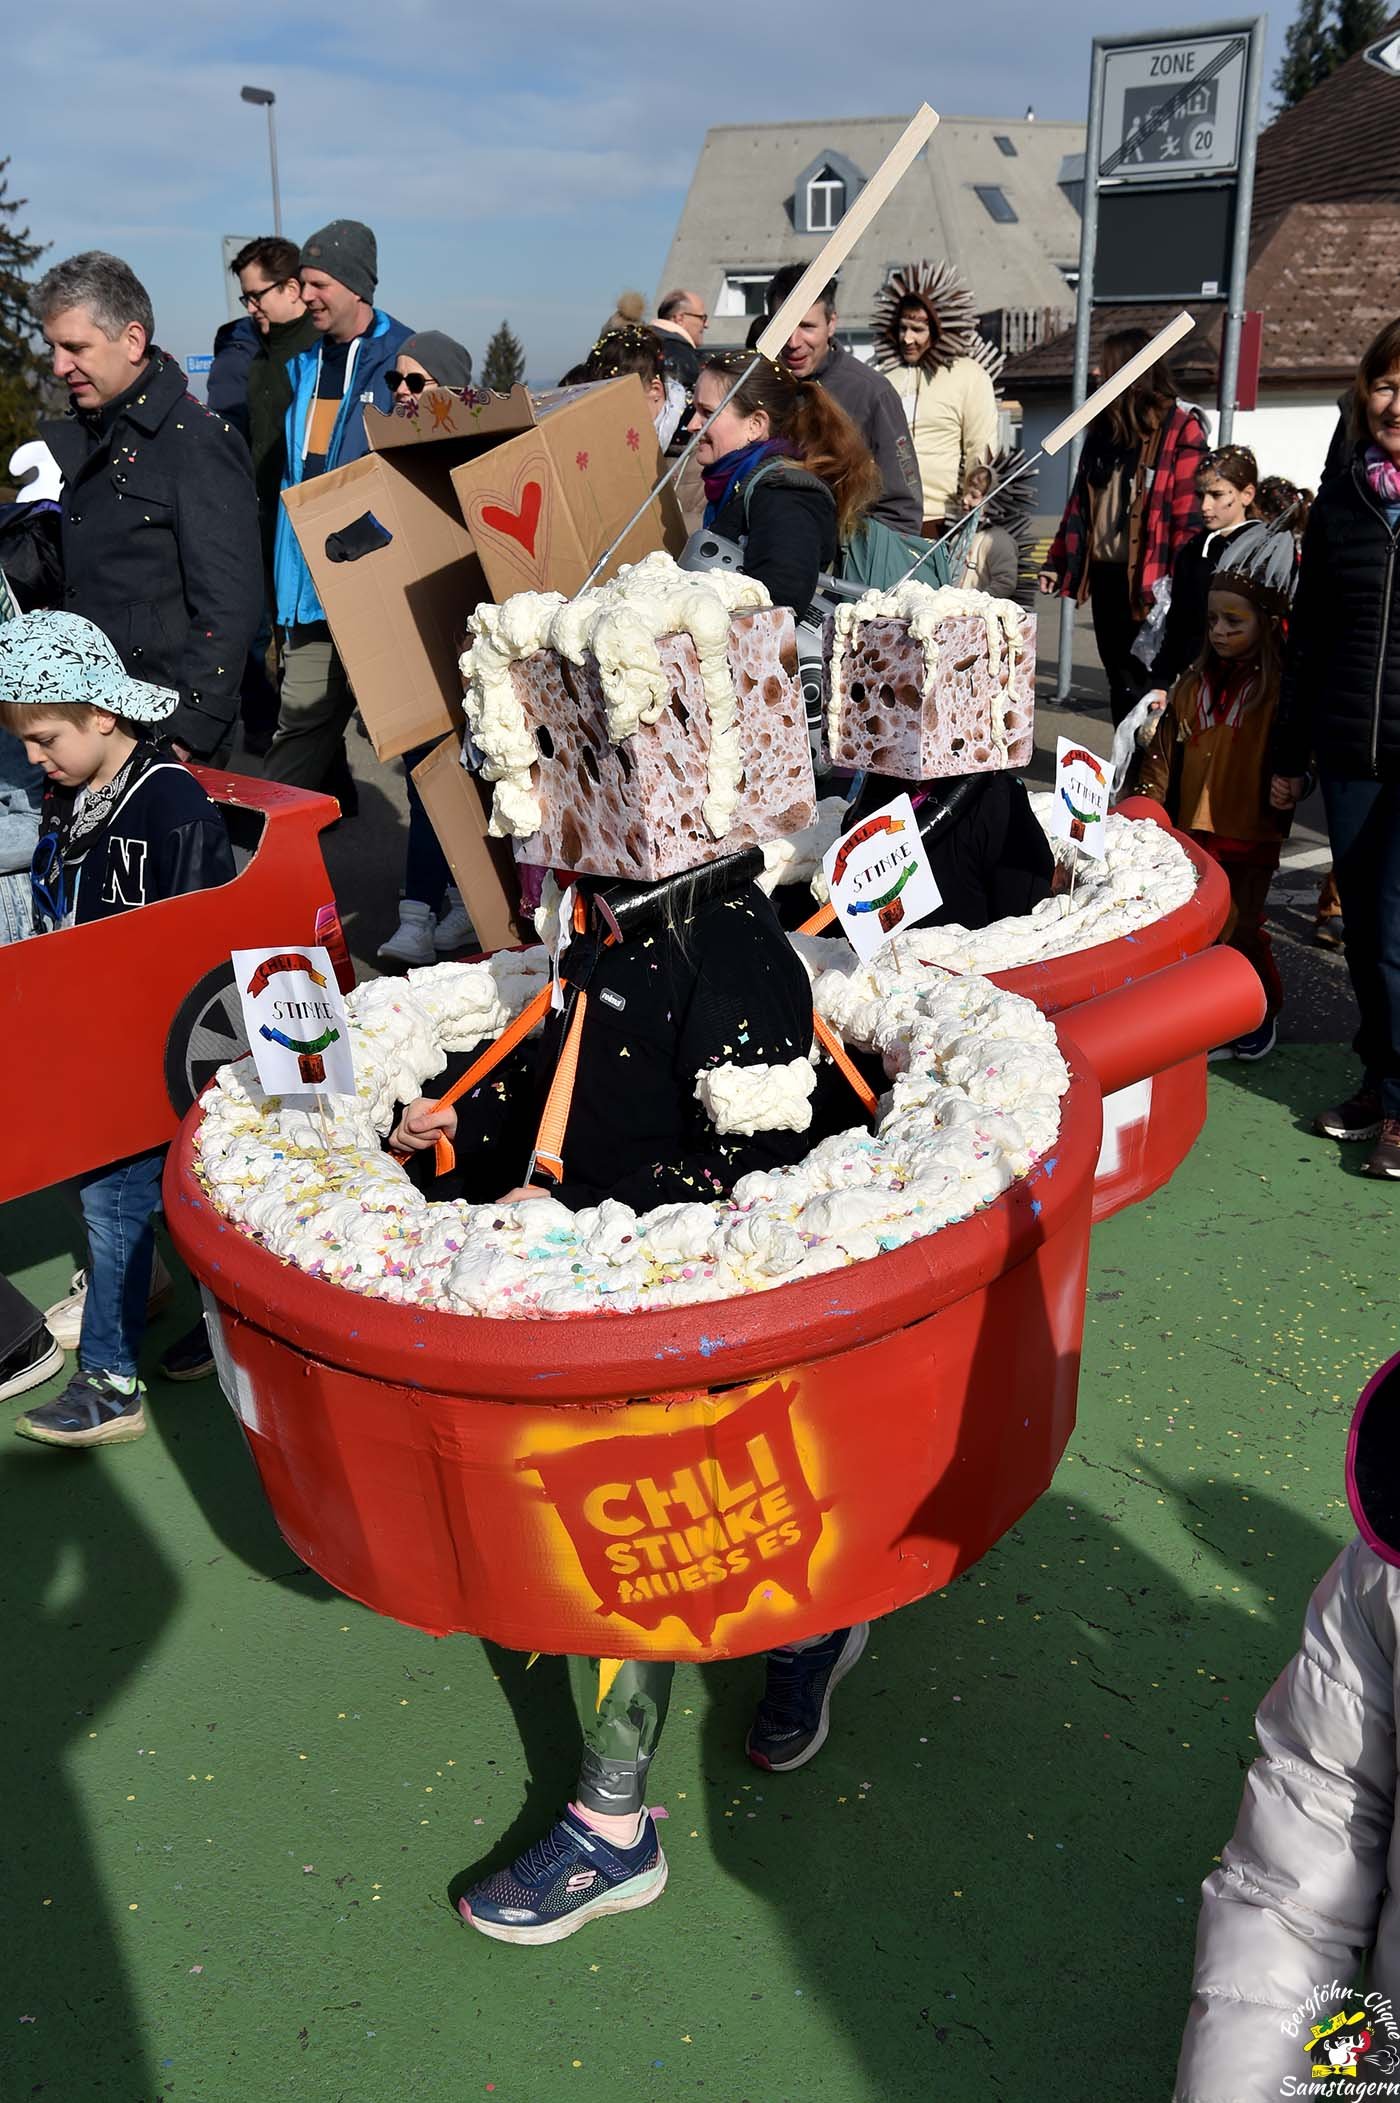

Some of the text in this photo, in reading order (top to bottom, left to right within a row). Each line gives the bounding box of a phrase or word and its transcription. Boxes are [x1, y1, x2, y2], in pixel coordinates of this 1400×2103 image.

[1150, 52, 1195, 77] ZONE
[1195, 130, 1213, 151] 20
[101, 836, 148, 906] N
[853, 842, 912, 893] STINKE
[272, 1000, 334, 1020] STINKE
[583, 1434, 780, 1536] CHLI
[605, 1487, 793, 1575] STINKE
[617, 1521, 802, 1603] MUESS ES
